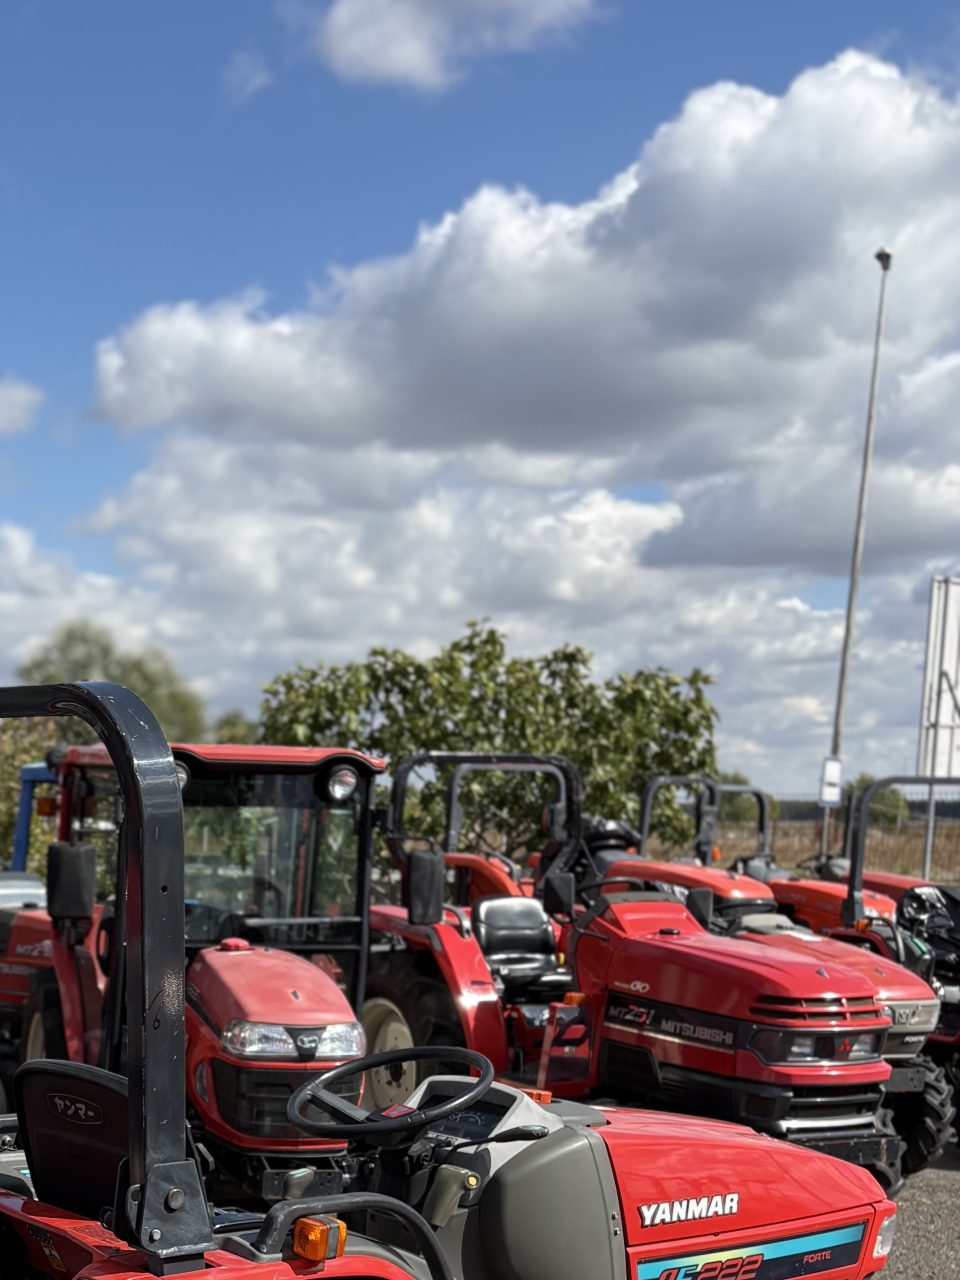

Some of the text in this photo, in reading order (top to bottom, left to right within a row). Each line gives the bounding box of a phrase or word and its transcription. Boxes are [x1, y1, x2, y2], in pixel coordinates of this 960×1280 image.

[660, 1019, 734, 1045] MITSUBISHI
[54, 1096, 95, 1120] ヤンマー
[639, 1193, 739, 1228] YANMAR
[802, 1250, 832, 1264] FORTE
